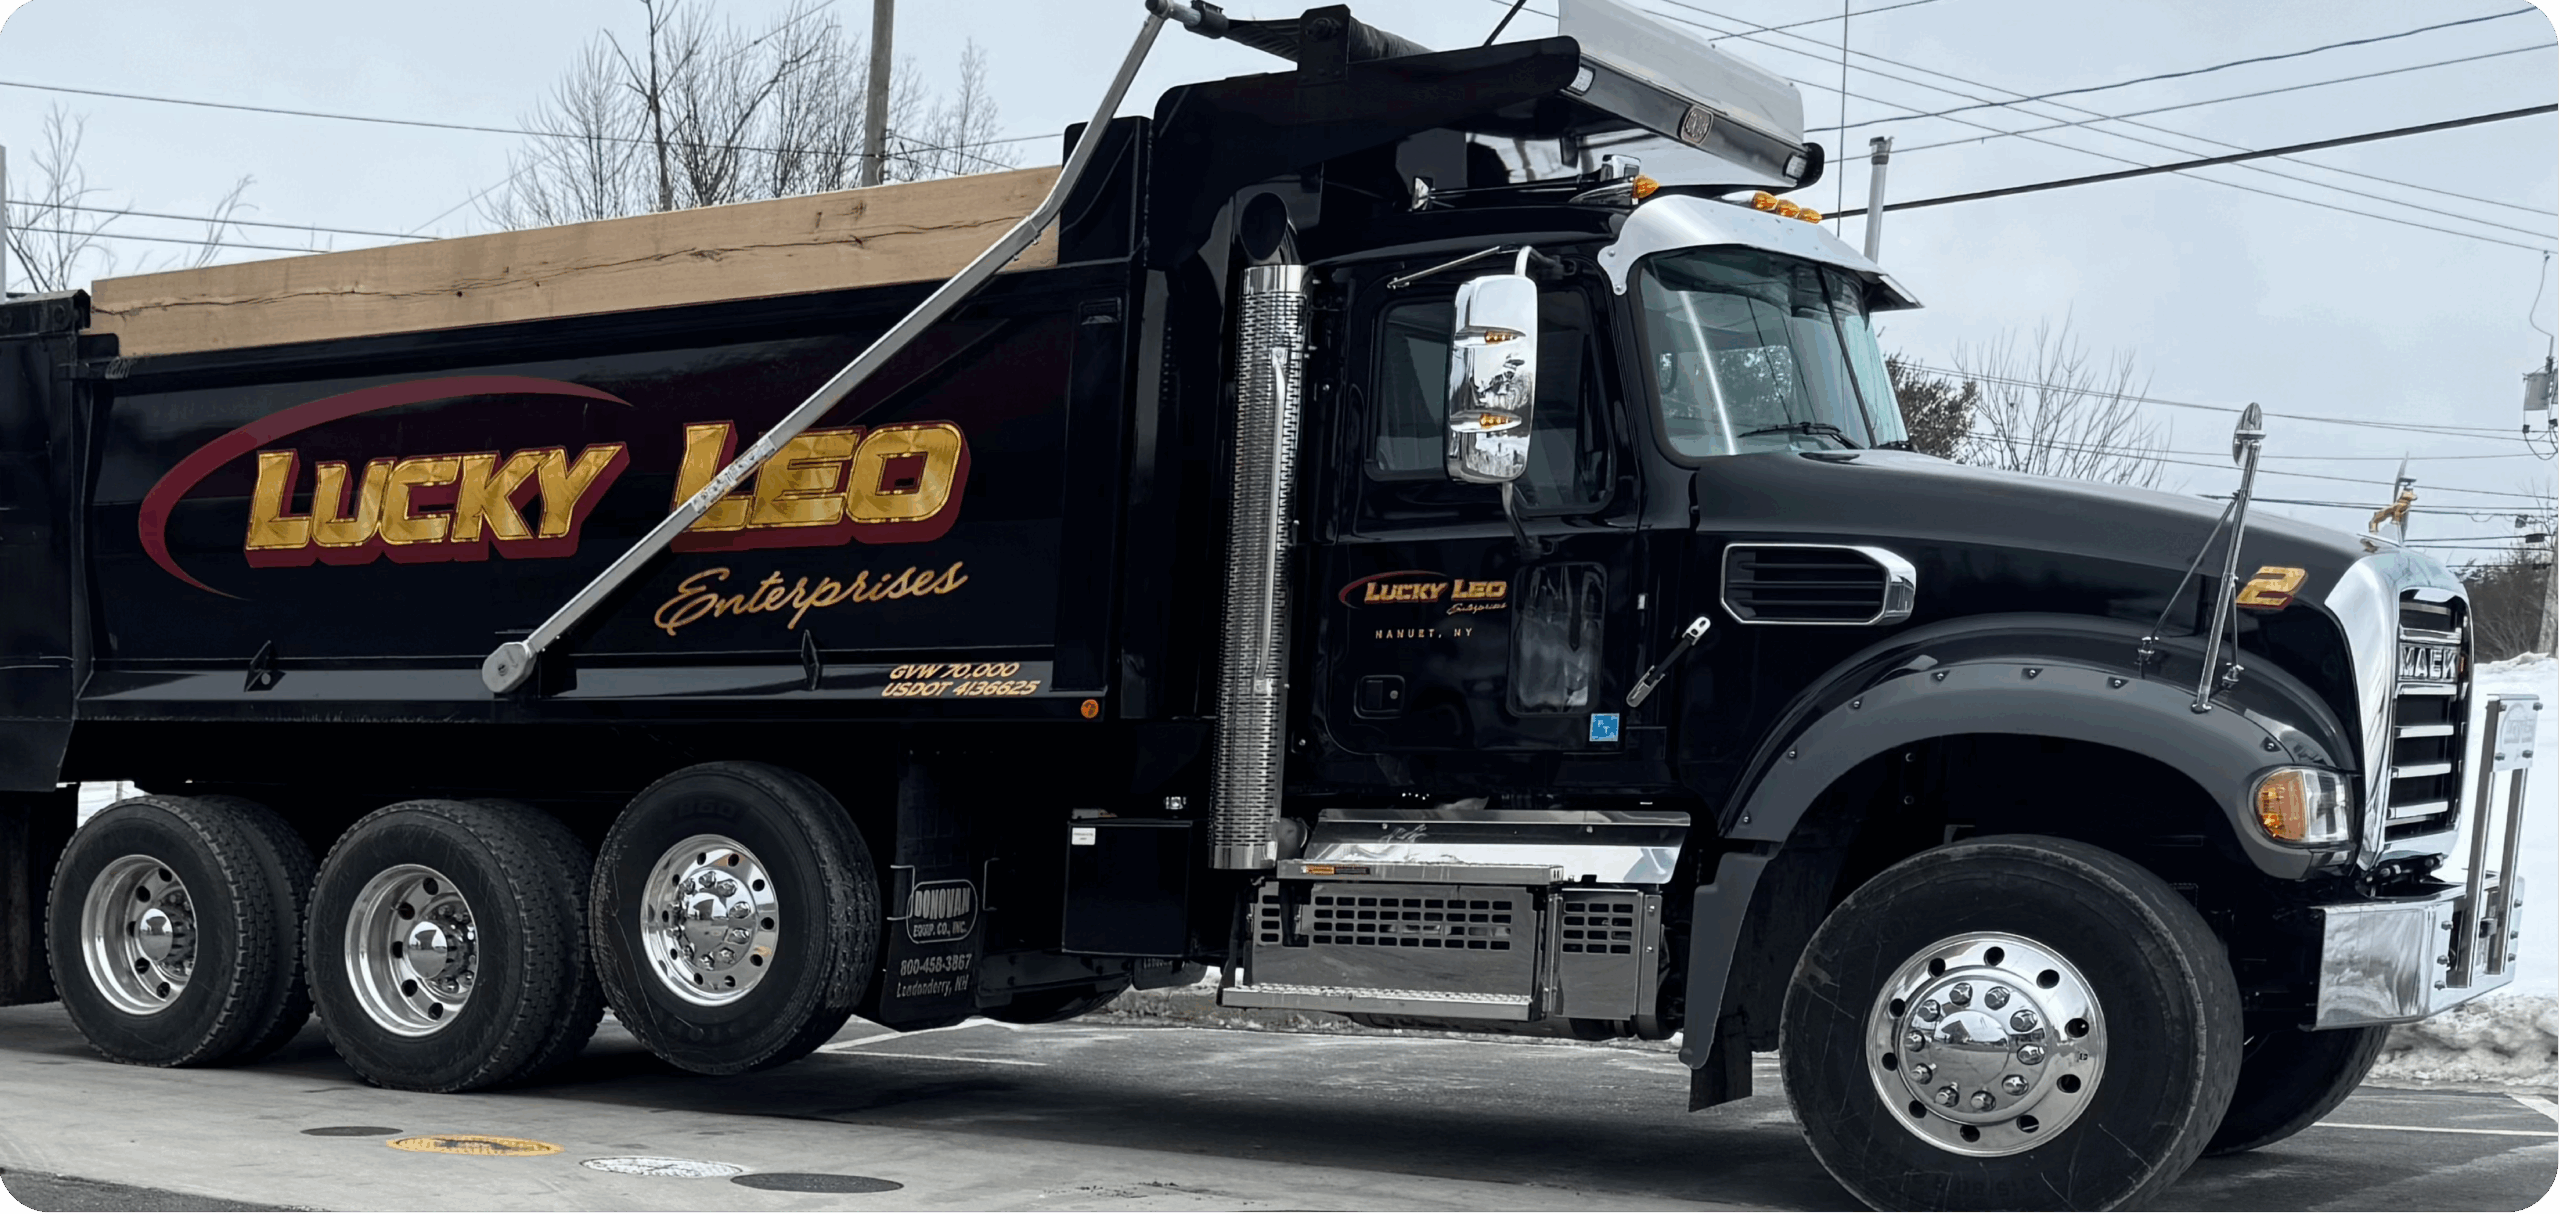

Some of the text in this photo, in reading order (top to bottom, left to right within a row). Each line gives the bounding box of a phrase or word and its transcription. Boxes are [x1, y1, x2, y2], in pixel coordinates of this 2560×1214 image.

[244, 442, 628, 555] LUCKY
[672, 420, 963, 534] LEO
[655, 561, 968, 636] Enterprises
[1364, 579, 1507, 602] LUCKY LEO
[2236, 565, 2307, 608] 2
[1453, 627, 1472, 637] NY
[889, 662, 1020, 680] GVW 70,000
[2399, 646, 2457, 679] MACK
[881, 680, 1041, 698] USDOT 4136625
[914, 887, 971, 920] DONOVAN
